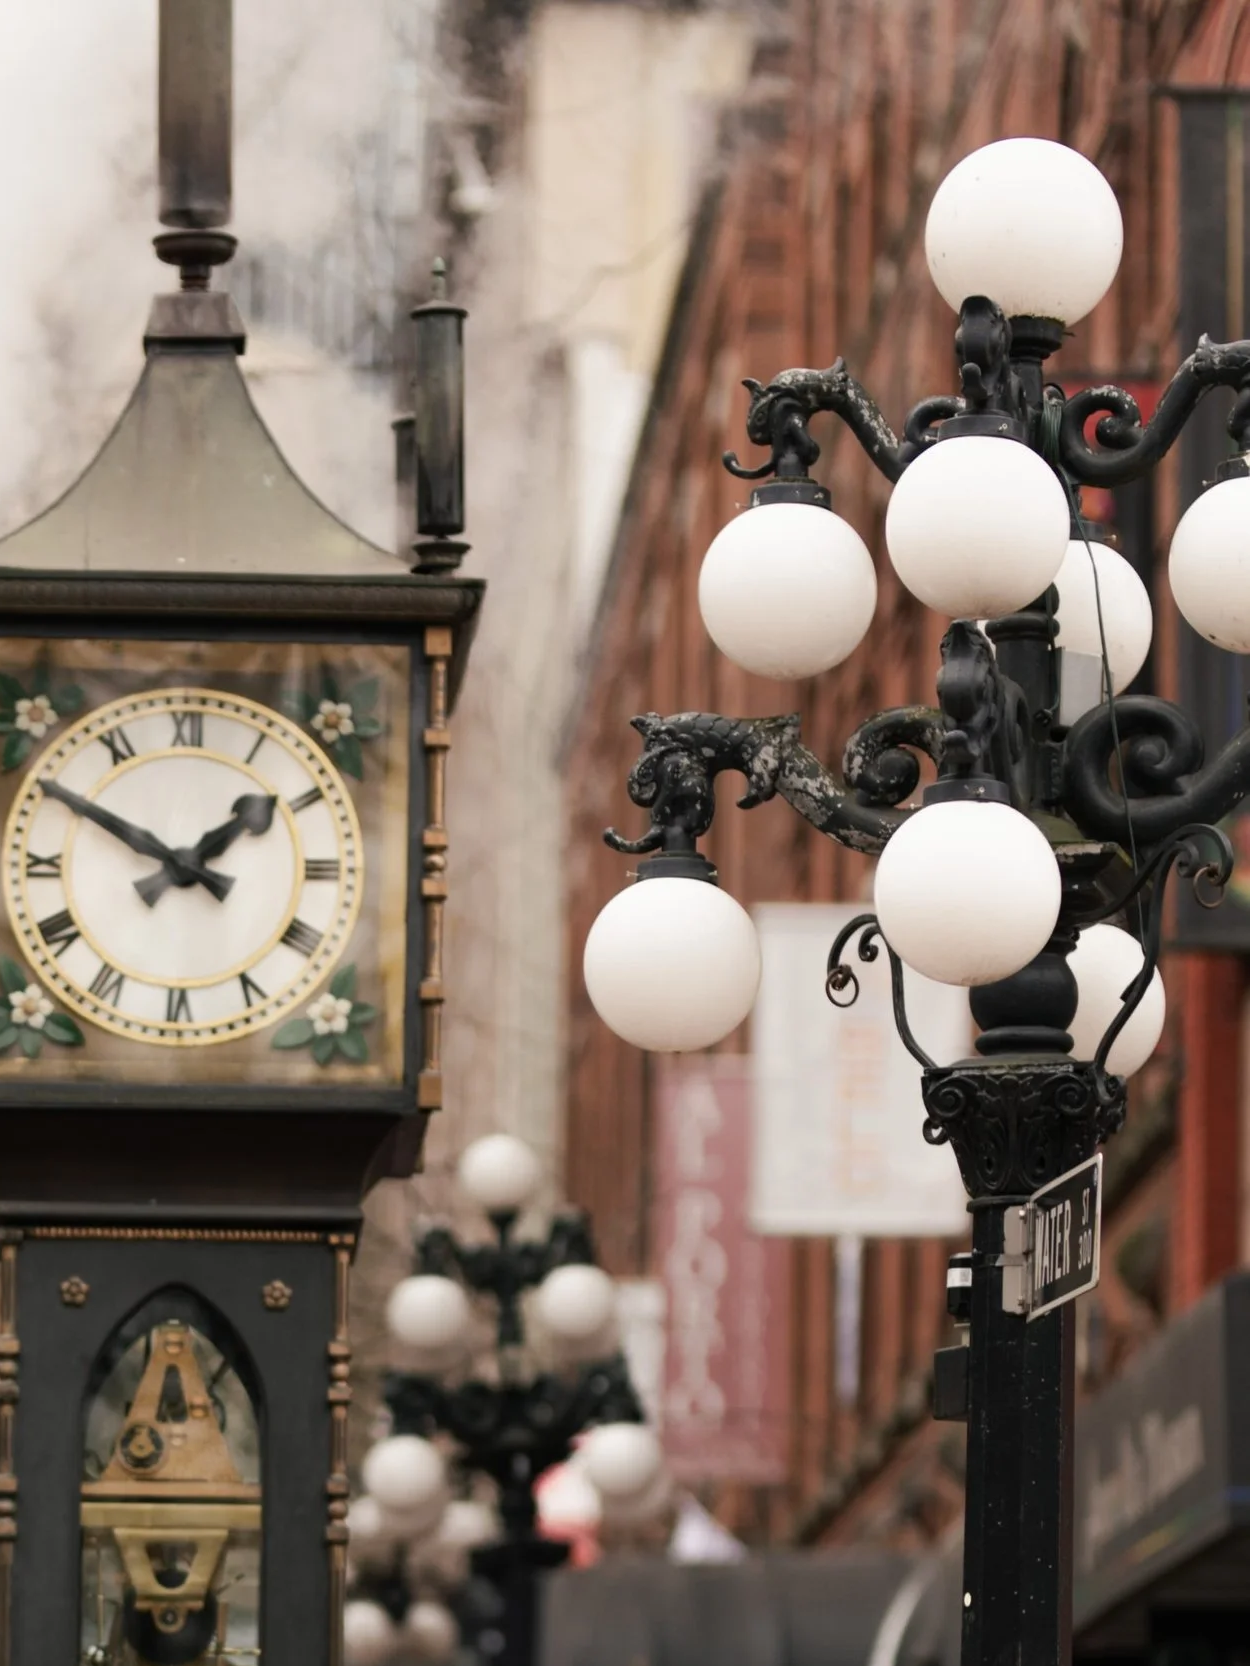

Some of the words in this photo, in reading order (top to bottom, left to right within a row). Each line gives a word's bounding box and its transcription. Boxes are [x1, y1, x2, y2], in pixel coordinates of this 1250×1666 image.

[171, 712, 204, 748] XII
[1035, 1200, 1071, 1290] WATER
[1082, 1187, 1090, 1226] ST
[1078, 1228, 1092, 1270] 300
